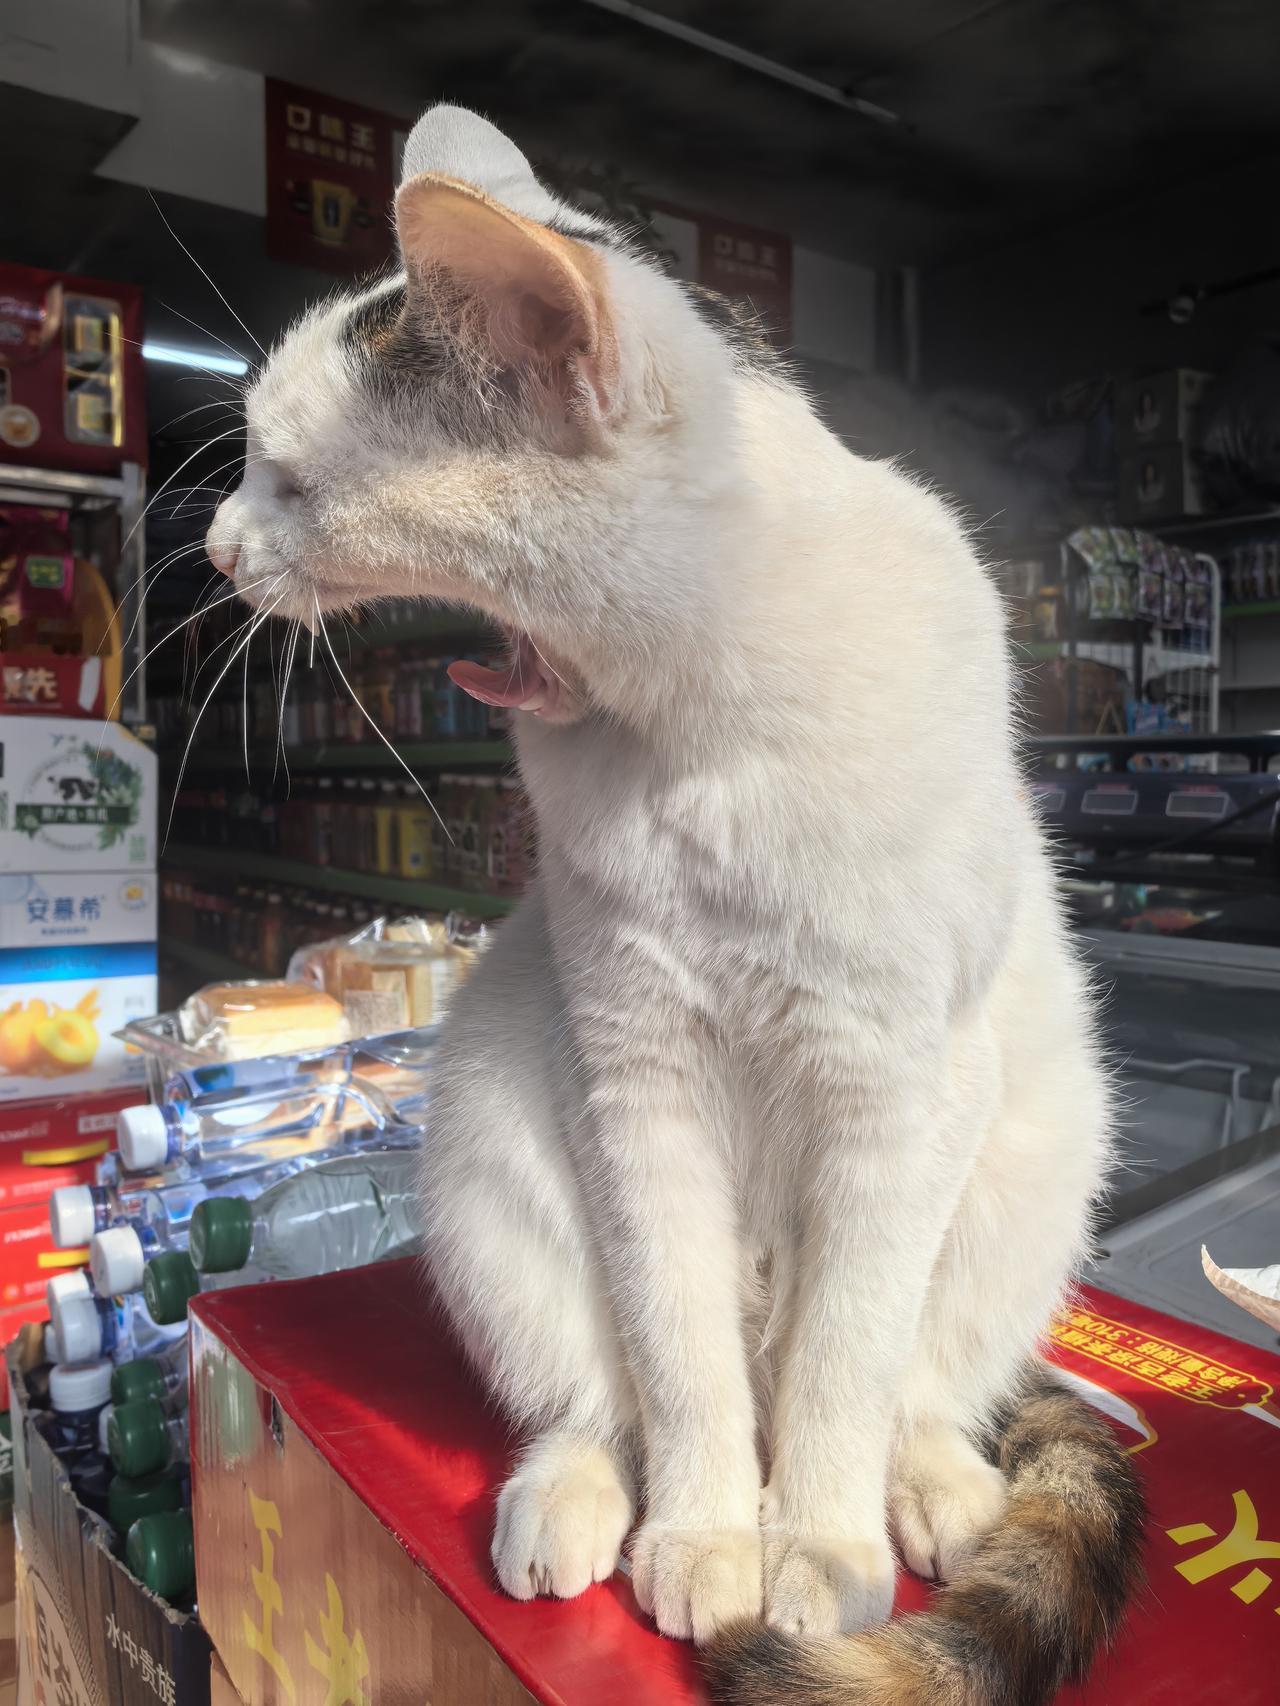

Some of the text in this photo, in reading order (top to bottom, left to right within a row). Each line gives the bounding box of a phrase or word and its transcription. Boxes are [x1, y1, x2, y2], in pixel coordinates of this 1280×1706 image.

[27, 896, 100, 923] 安慕希
[106, 1612, 177, 1706] 水中贵族
